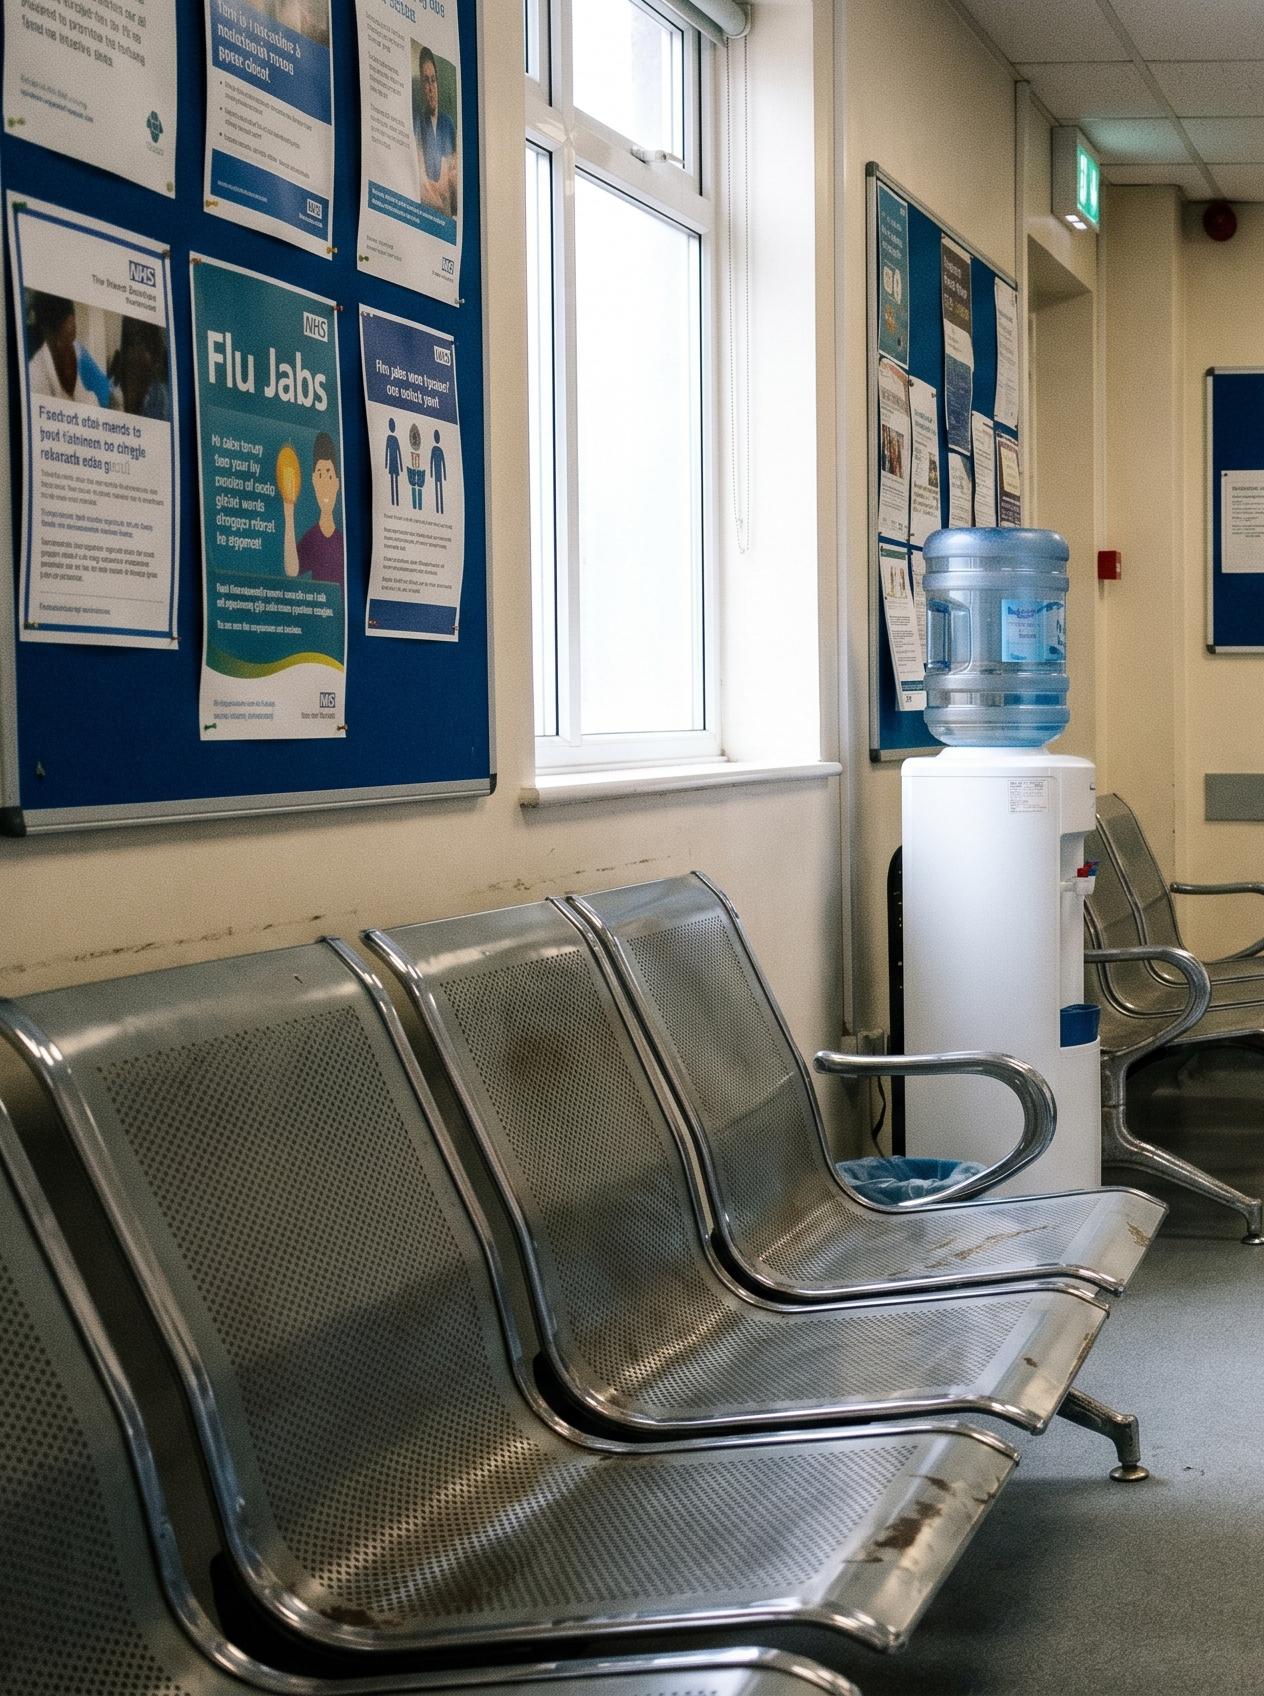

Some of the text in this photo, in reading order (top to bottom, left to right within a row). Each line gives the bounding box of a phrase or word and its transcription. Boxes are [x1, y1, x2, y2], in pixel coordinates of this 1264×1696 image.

[130, 262, 155, 286] NHS
[305, 315, 327, 339] NHS
[207, 329, 328, 412] Flu Jabs
